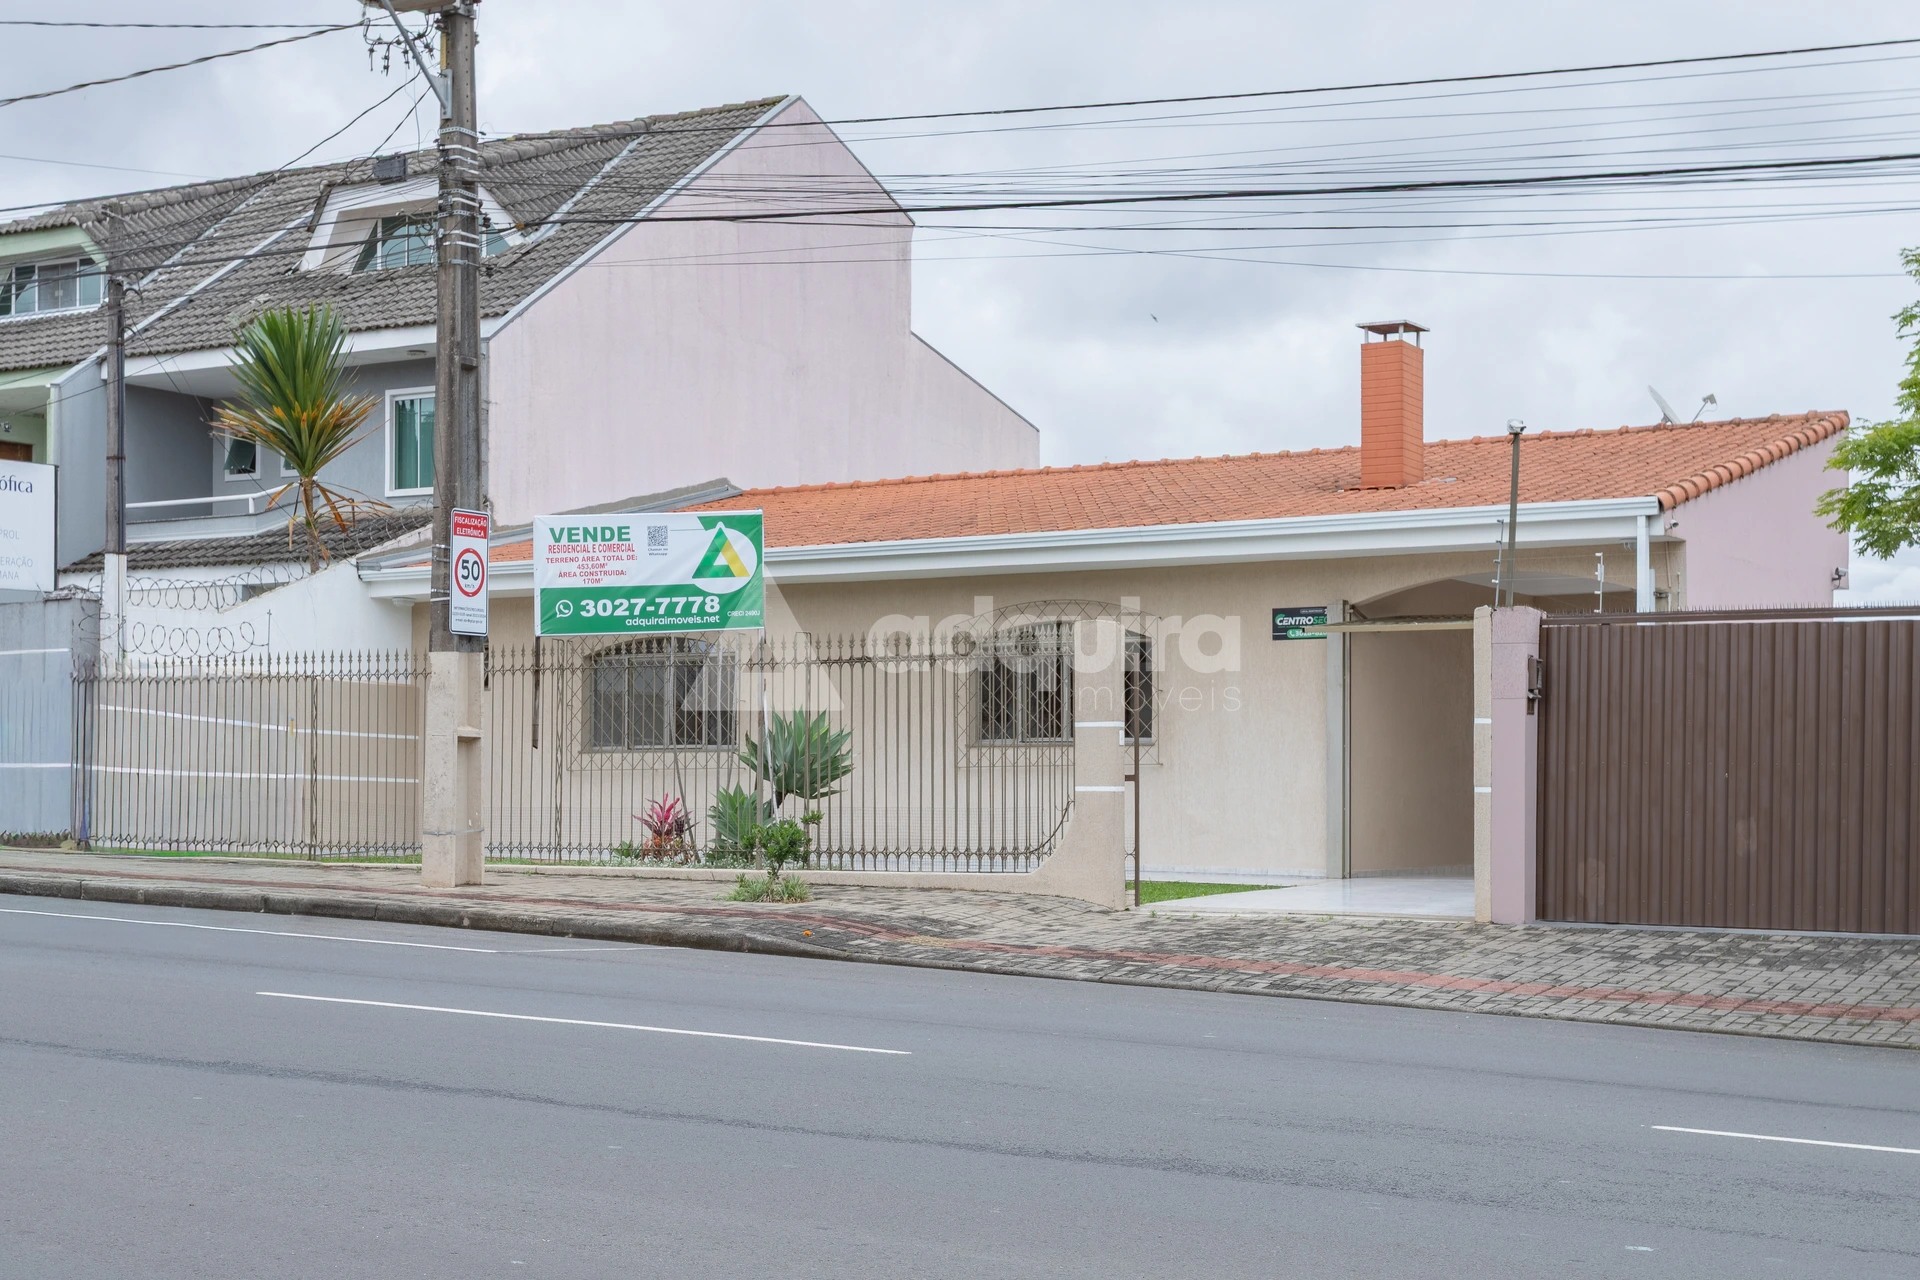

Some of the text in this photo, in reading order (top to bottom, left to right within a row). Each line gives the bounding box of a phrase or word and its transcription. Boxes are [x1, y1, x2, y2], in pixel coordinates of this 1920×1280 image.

[454, 515, 487, 528] FISCALIZAÇÃO
[456, 527, 485, 538] ELETRÔNICA
[549, 526, 631, 543] VENDE
[548, 543, 635, 554] RESIDENCIAL E COMERCIAL
[545, 556, 579, 564] TERRENO
[461, 559, 480, 581] 50
[580, 596, 720, 617] 3027-7778
[625, 615, 720, 627] adquiraimoveis.net
